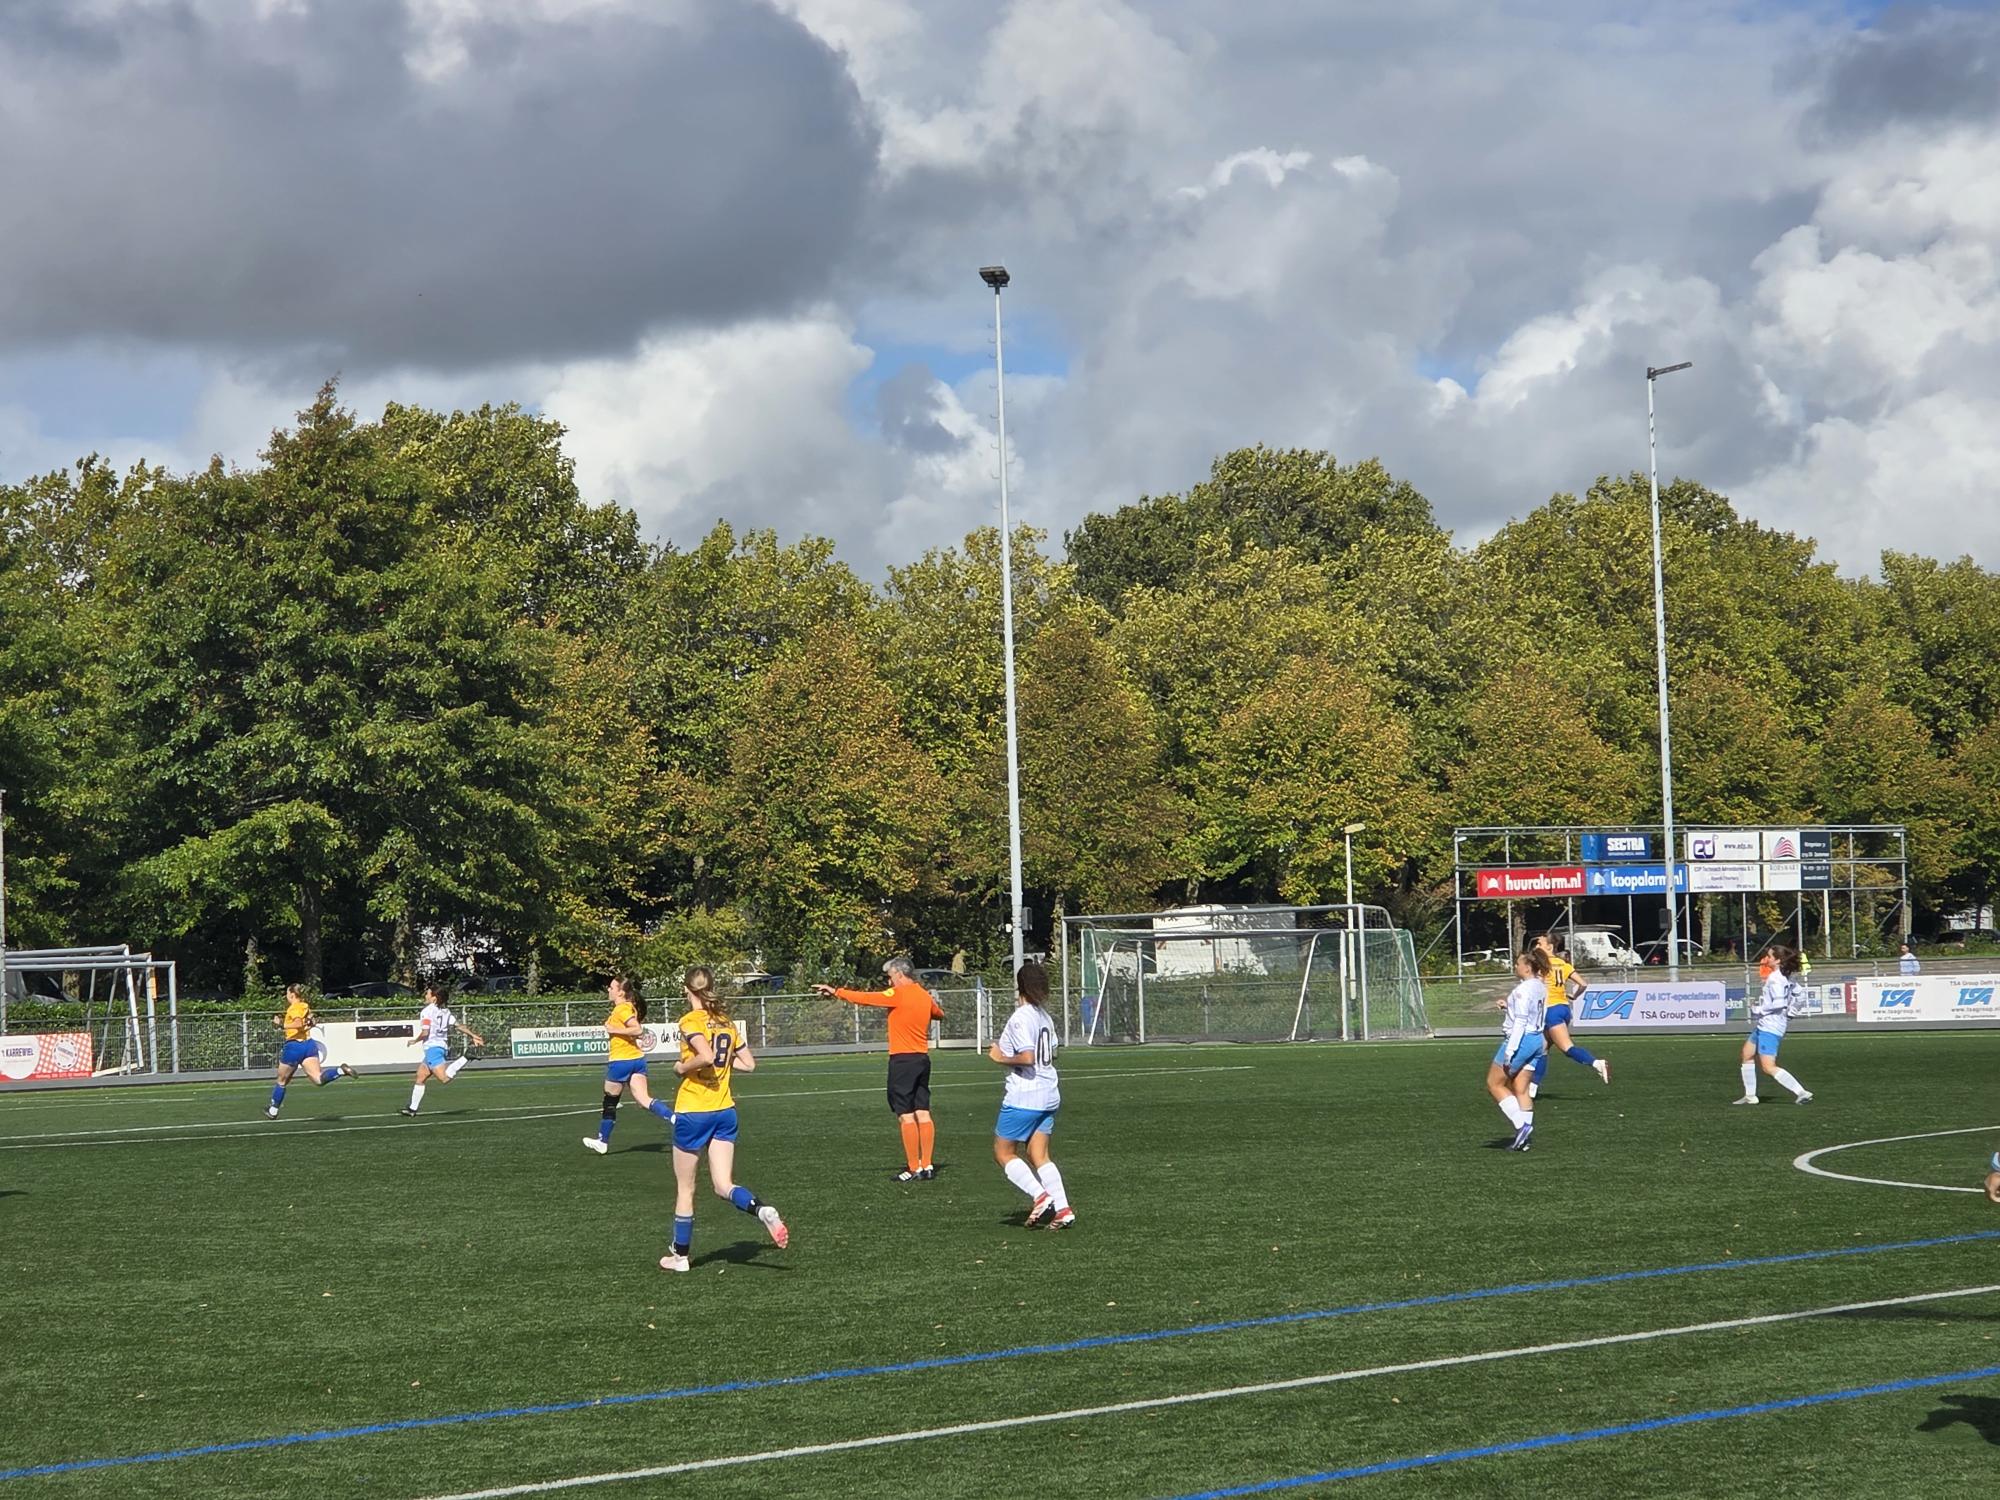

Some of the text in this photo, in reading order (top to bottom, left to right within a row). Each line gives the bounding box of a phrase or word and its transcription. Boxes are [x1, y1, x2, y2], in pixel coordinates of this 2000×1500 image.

[1607, 837, 1646, 851] SECTRA
[1505, 872, 1581, 891] huuralarm.nl
[1610, 869, 1683, 891] koopalarmnl
[1555, 969, 1563, 987] 11
[1658, 992, 1720, 1003] ICT-specialisten
[1640, 1009, 1720, 1020] TSA Group Delft bv
[535, 1029, 605, 1040] Winkeliersvereniging
[517, 1040, 610, 1054] REMBRANDT ROTO
